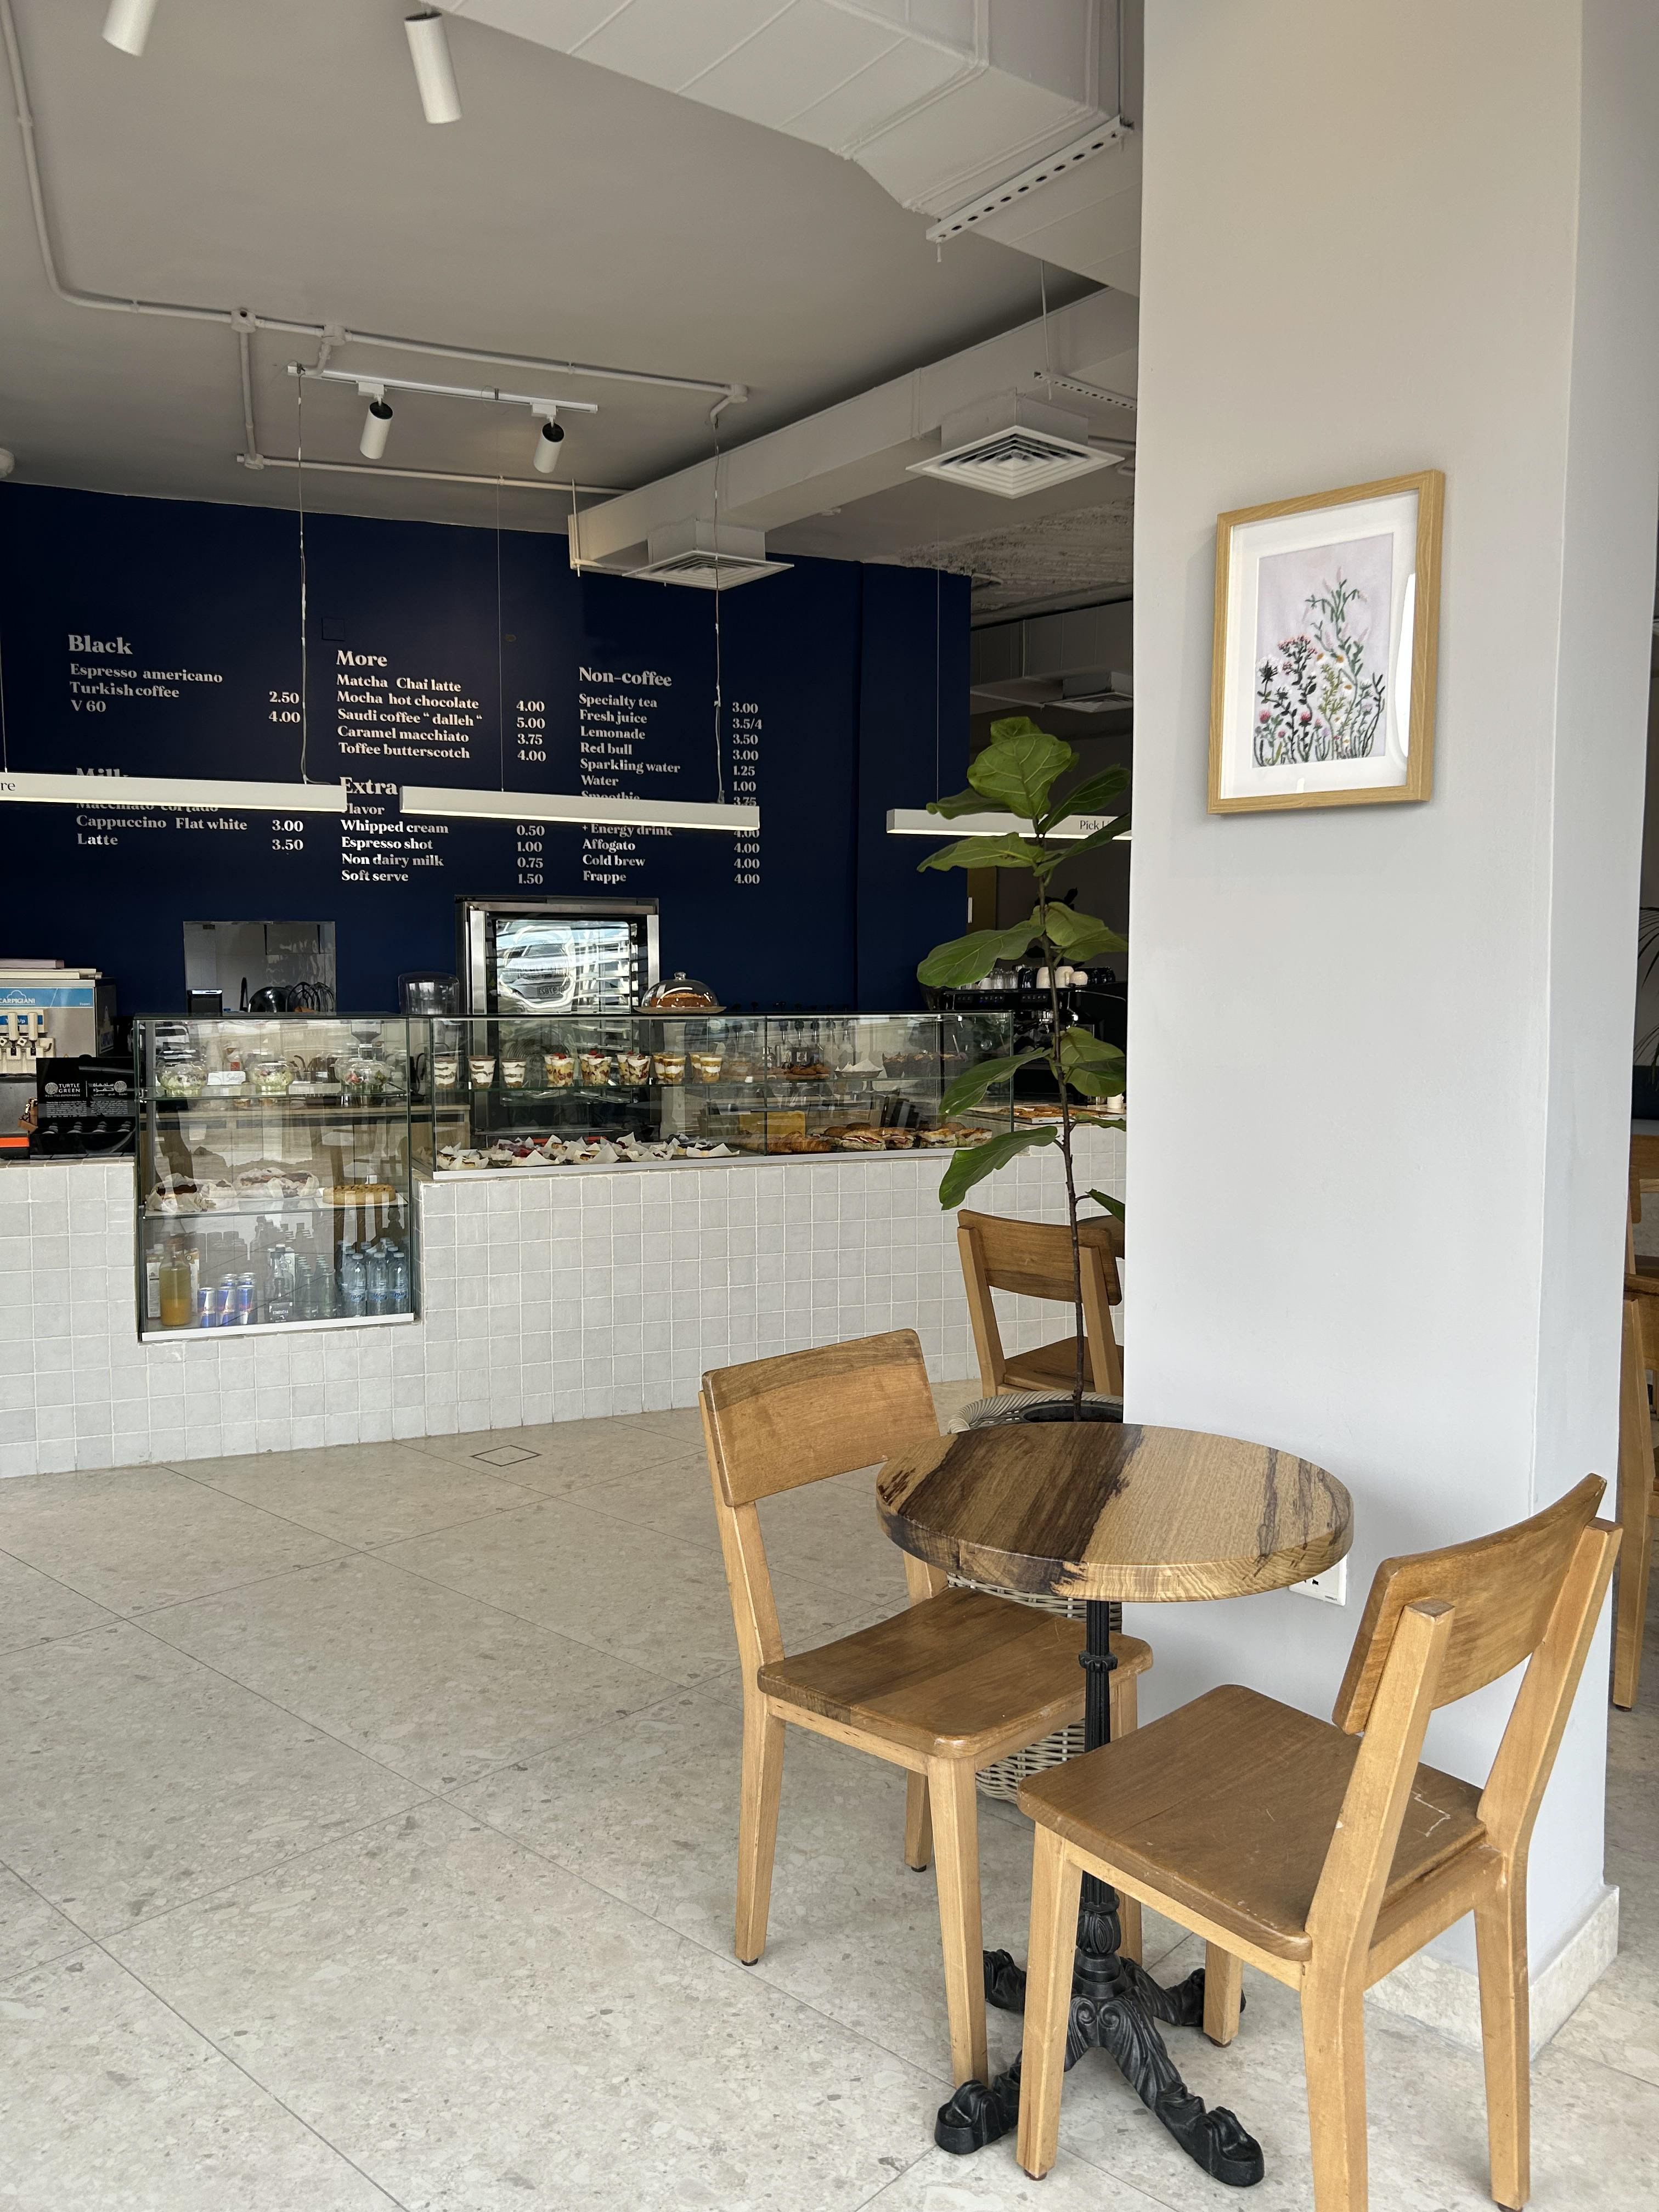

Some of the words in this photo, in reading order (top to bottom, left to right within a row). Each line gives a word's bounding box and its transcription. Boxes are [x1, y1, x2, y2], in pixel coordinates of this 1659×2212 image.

[68, 634, 133, 654] Black
[336, 650, 387, 667] More
[70, 663, 137, 679] Espresso
[143, 669, 223, 683] americano
[579, 667, 672, 687] Non-coffee
[69, 681, 134, 696] Turkish
[135, 685, 180, 698] coffee
[337, 674, 388, 688] Matcha
[396, 678, 428, 690] Chai
[431, 679, 461, 692] latte
[269, 691, 300, 704] 2.50
[337, 690, 383, 704] Mocha
[388, 693, 412, 706] hot
[414, 695, 479, 709] chocolate
[579, 693, 636, 709] Specialty
[638, 697, 657, 708] tea
[70, 699, 82, 712] V
[86, 700, 106, 712] 60
[516, 700, 545, 712] 4.00
[732, 702, 758, 714] 3.00
[268, 710, 301, 723] 4.00
[337, 708, 377, 721] Saudi
[379, 711, 421, 724] coffee
[432, 713, 474, 726] dalleh
[516, 716, 545, 729] 5.00
[579, 709, 615, 722] Fresh
[615, 711, 647, 725] juice
[732, 718, 762, 730] 3.5/4
[337, 725, 397, 739] Caramel
[399, 729, 469, 742] macchiato
[517, 733, 543, 745] 3.75
[580, 725, 646, 740] Lemonade
[732, 733, 758, 745] 3.50
[338, 742, 381, 755] Toffee
[383, 743, 470, 759] butterscotch
[517, 749, 546, 761] 4.00
[580, 742, 605, 754] Red
[607, 743, 632, 755] bull
[732, 749, 759, 761] 3.00
[76, 768, 128, 777] Mil
[580, 758, 644, 775] Sparkling
[645, 763, 681, 773] water
[733, 765, 755, 776] 1.25
[340, 777, 398, 795] Extra
[580, 775, 619, 786] Water
[733, 781, 757, 792] 1.00
[76, 815, 167, 830] Cappuccino
[175, 817, 205, 829] Flat
[206, 818, 247, 830] white
[272, 820, 303, 832] 3.00
[340, 819, 404, 834] Whipped
[406, 825, 449, 834] cream
[1080, 820, 1099, 830] Pick
[516, 825, 545, 836] 0.50
[591, 825, 634, 837] Energy
[637, 826, 672, 836] drink
[77, 833, 118, 845] Latte
[272, 839, 303, 850] 3.50
[341, 836, 402, 851] Espresso
[403, 837, 433, 850] shot
[582, 838, 636, 853] Affogato
[517, 841, 543, 852] 1.00
[733, 843, 760, 854] 4.00
[342, 853, 370, 865] Non
[373, 853, 409, 868] dairy
[412, 854, 444, 866] milk
[517, 857, 544, 868] 0.75
[582, 854, 612, 866] Cold
[614, 855, 646, 866] brew
[733, 858, 760, 869] 4.00
[341, 870, 370, 881] Soft
[372, 873, 409, 882] serve
[518, 873, 543, 884] 1.50
[583, 870, 627, 884] Frappe
[734, 873, 760, 884] 4.00
